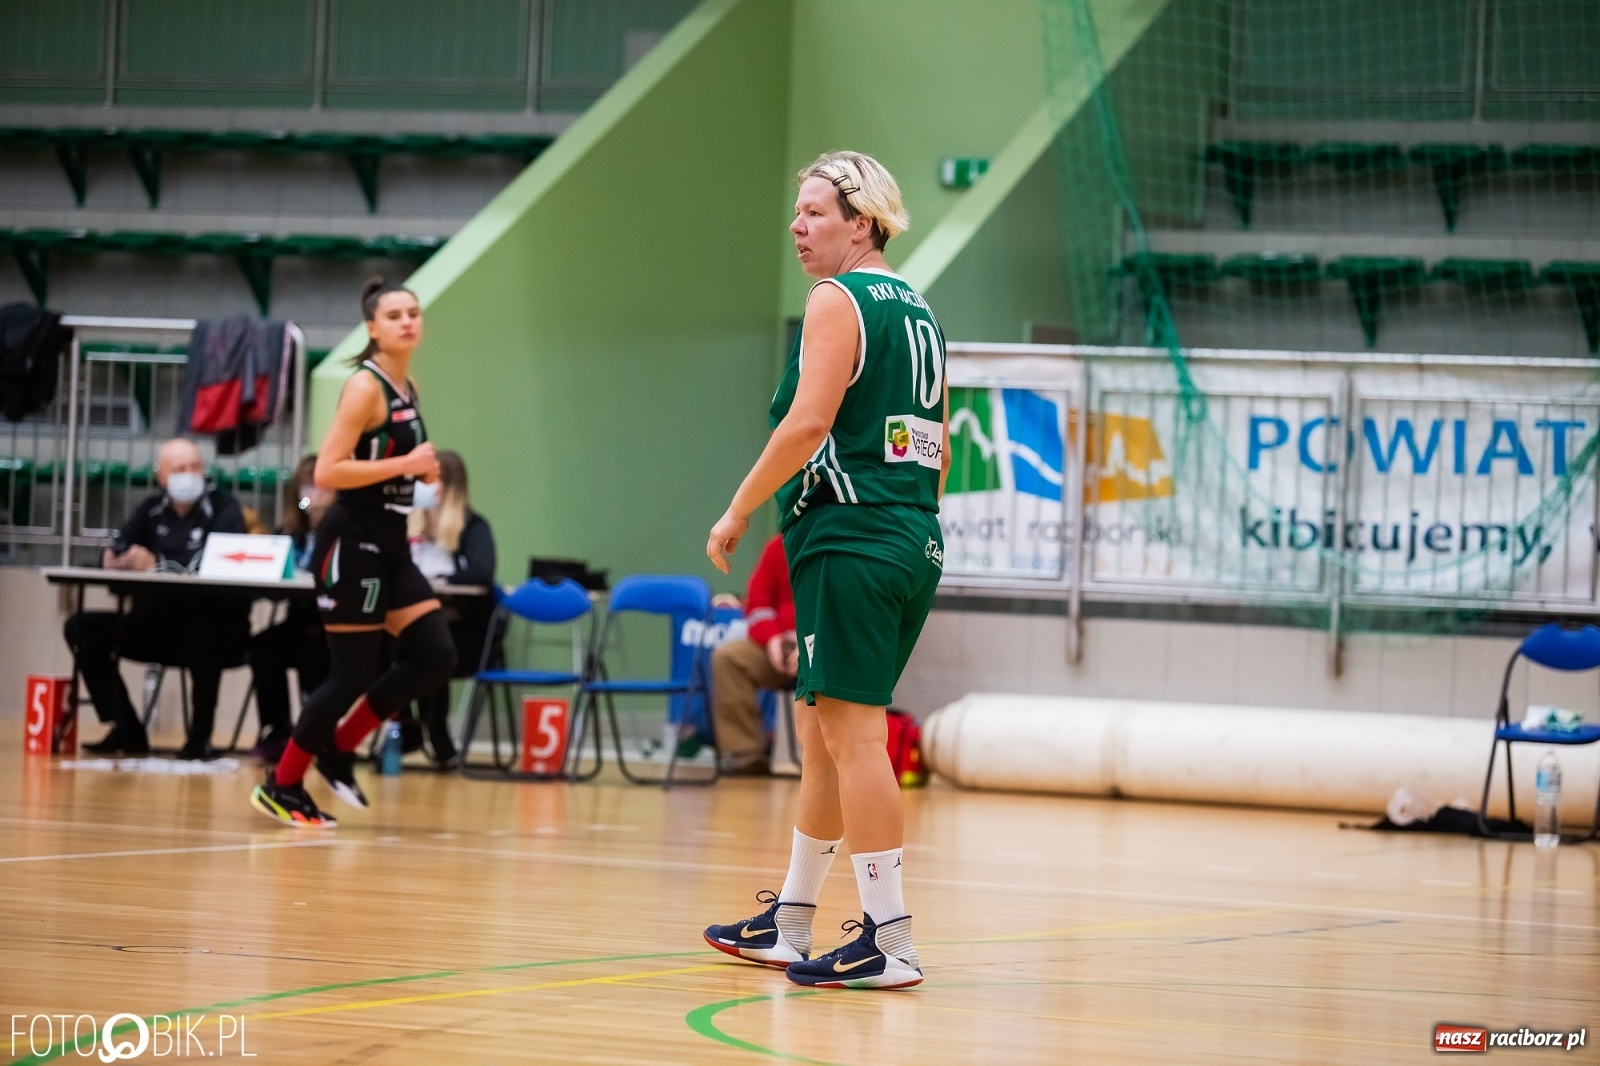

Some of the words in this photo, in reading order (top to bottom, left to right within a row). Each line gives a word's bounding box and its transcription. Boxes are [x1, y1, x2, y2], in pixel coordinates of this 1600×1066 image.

[867, 282, 898, 302] RKK
[904, 315, 942, 410] 10
[1248, 415, 1586, 477] POWIAT
[1239, 506, 1553, 567] kibicujemy,
[360, 577, 381, 614] 7
[28, 682, 47, 736] 5
[529, 704, 563, 759] 5
